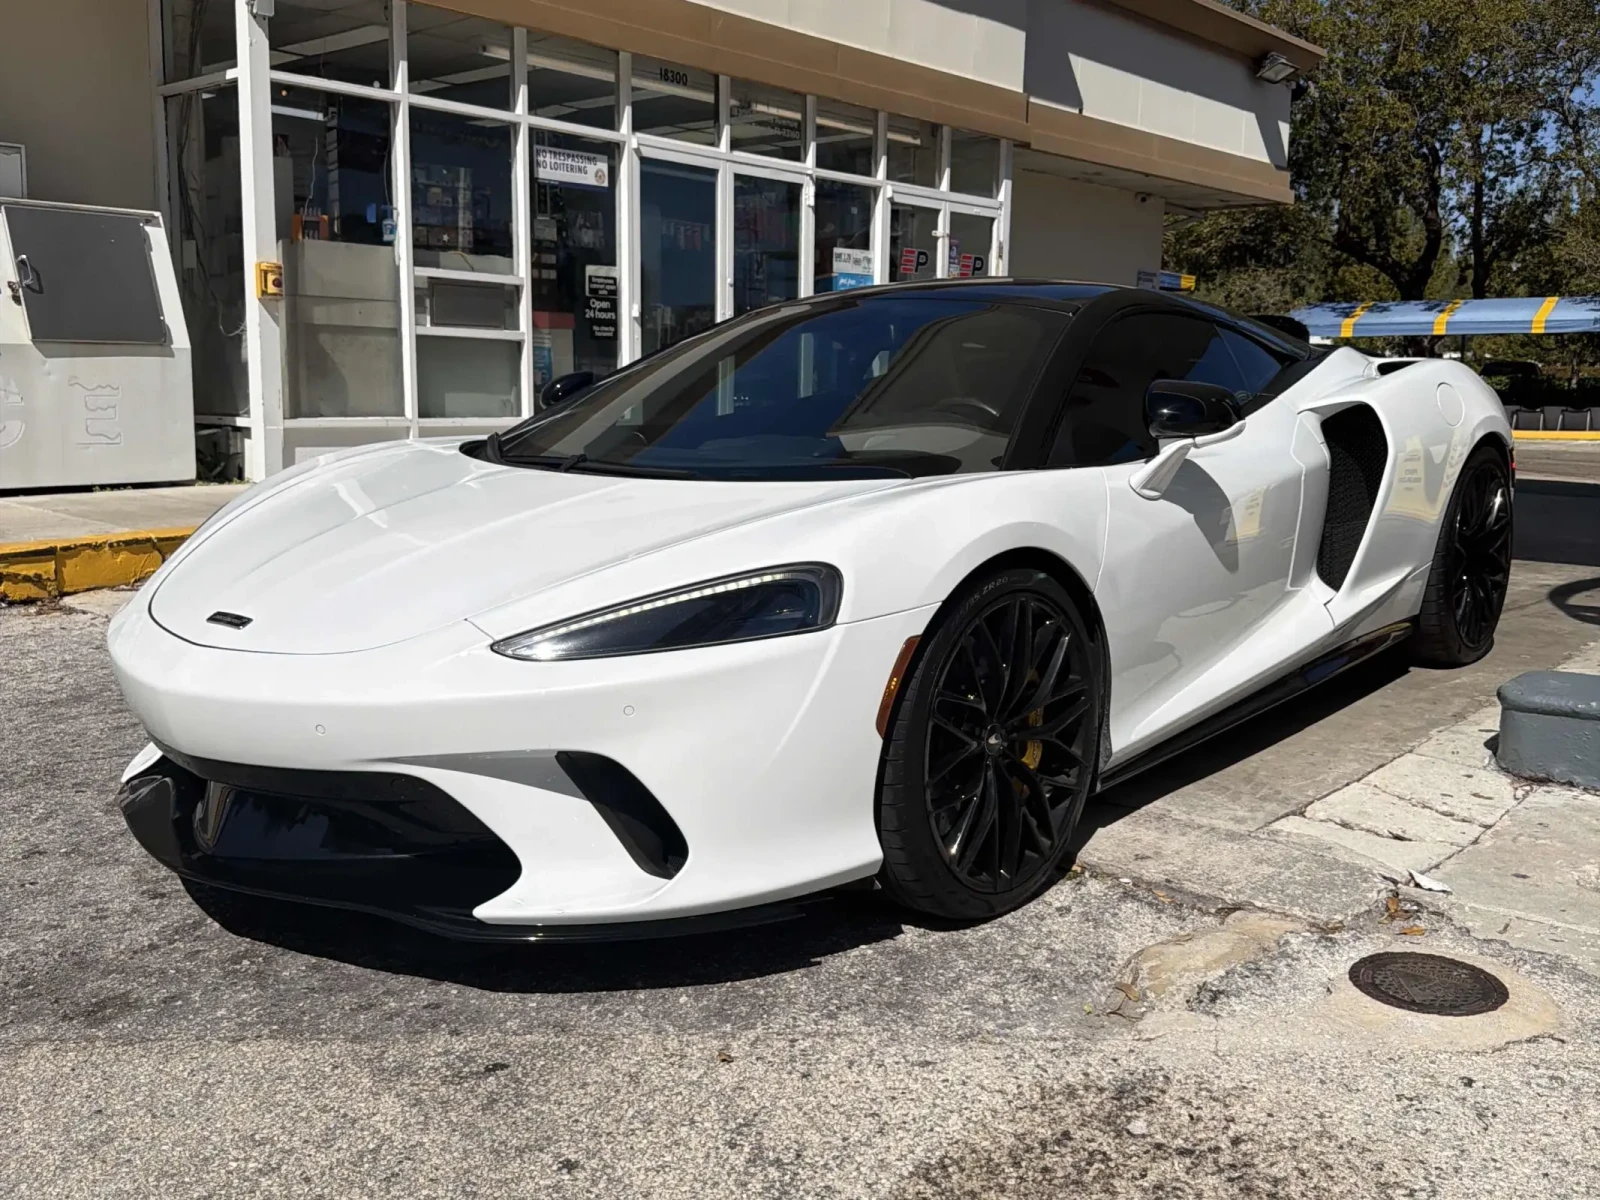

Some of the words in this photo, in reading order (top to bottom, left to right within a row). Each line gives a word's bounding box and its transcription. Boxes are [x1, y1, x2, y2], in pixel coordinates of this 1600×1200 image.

[659, 67, 688, 86] 18300
[536, 148, 548, 159] NO
[549, 150, 598, 166] TRESPASSING
[536, 159, 548, 169] NO
[549, 161, 588, 175] LOITERING
[589, 298, 611, 310] Open
[585, 308, 595, 318] 24
[595, 309, 616, 320] hours
